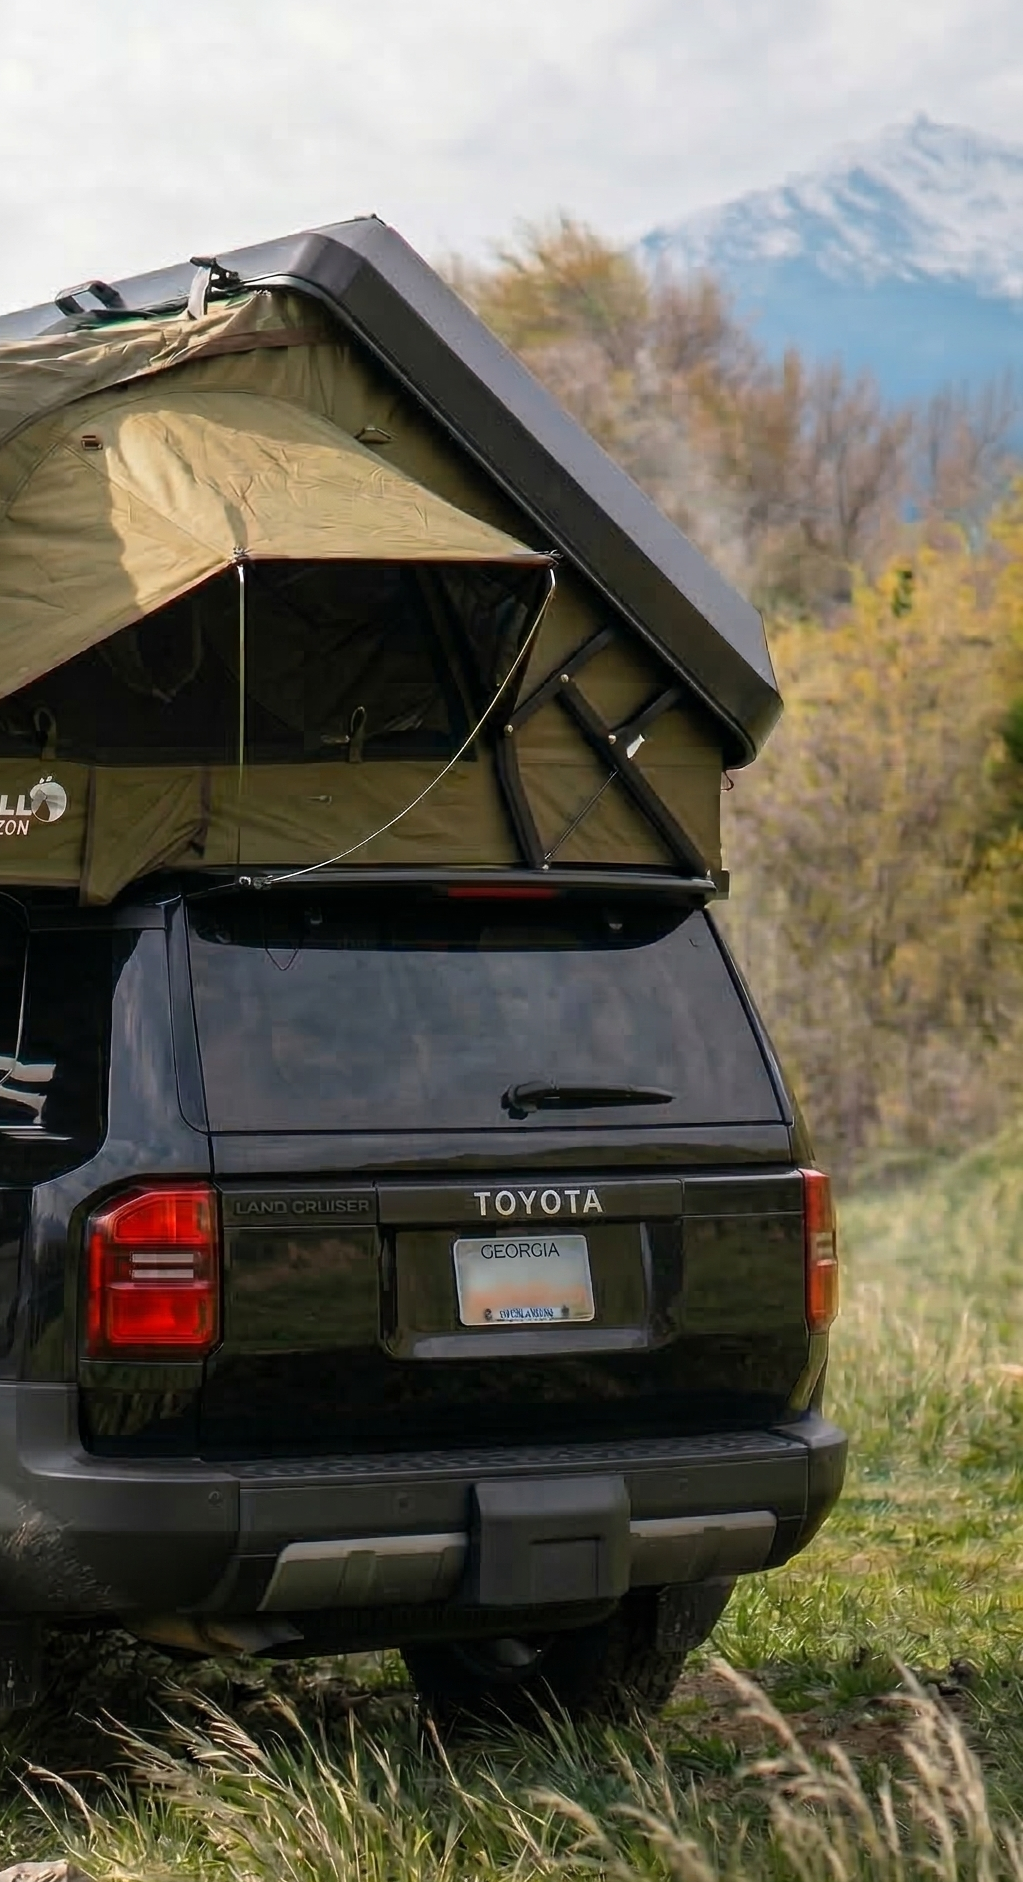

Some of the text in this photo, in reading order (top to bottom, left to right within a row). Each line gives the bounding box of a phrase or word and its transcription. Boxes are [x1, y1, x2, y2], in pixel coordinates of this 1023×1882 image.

[235, 1199, 370, 1215] LAND CRUISER
[474, 1188, 603, 1216] TOYOTA
[480, 1242, 560, 1259] GEORGIA
